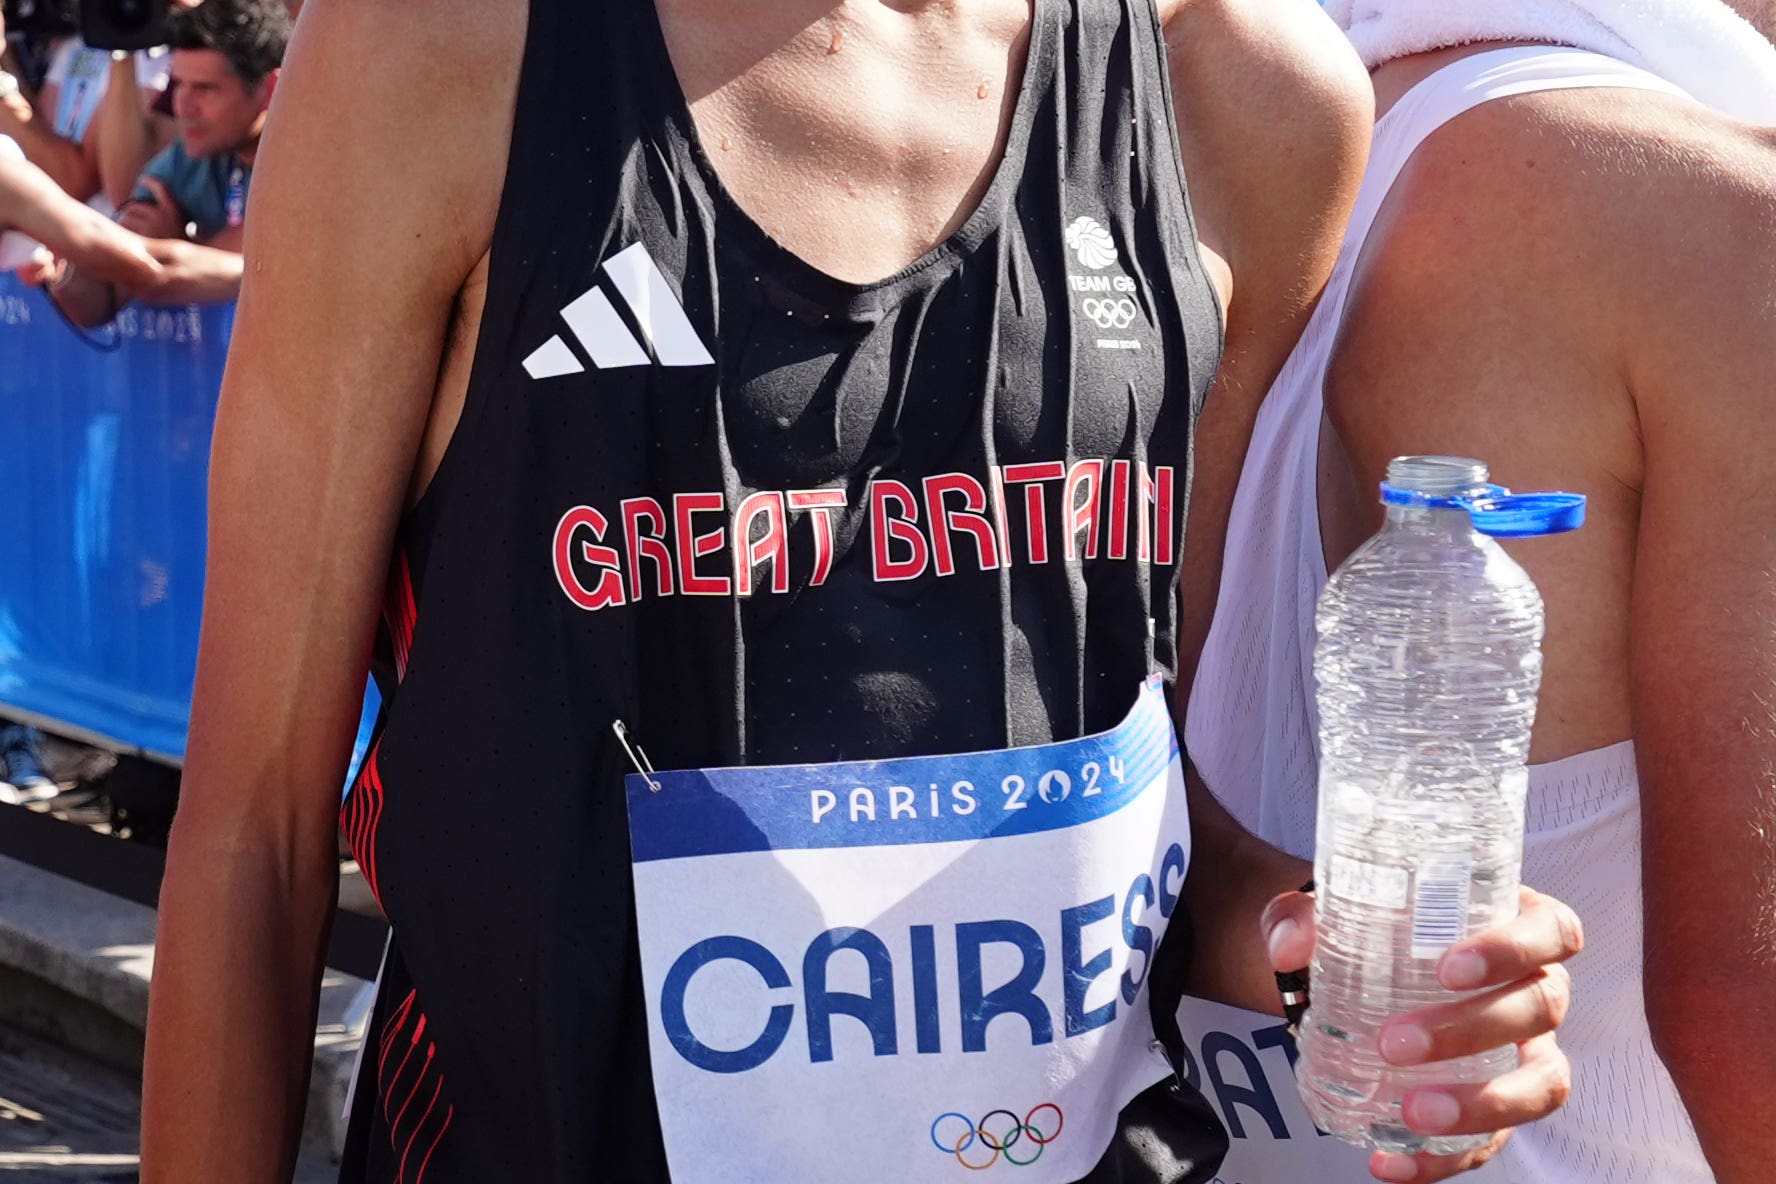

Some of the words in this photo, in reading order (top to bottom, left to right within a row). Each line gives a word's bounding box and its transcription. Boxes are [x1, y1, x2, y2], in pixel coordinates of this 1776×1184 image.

[1067, 274, 1112, 292] TEAM
[1112, 275, 1137, 292] GB
[552, 488, 848, 612] GREAT
[870, 458, 1174, 583] BRITAIN
[1000, 755, 1125, 812] 2024
[660, 842, 1185, 1074] CAIRESS
